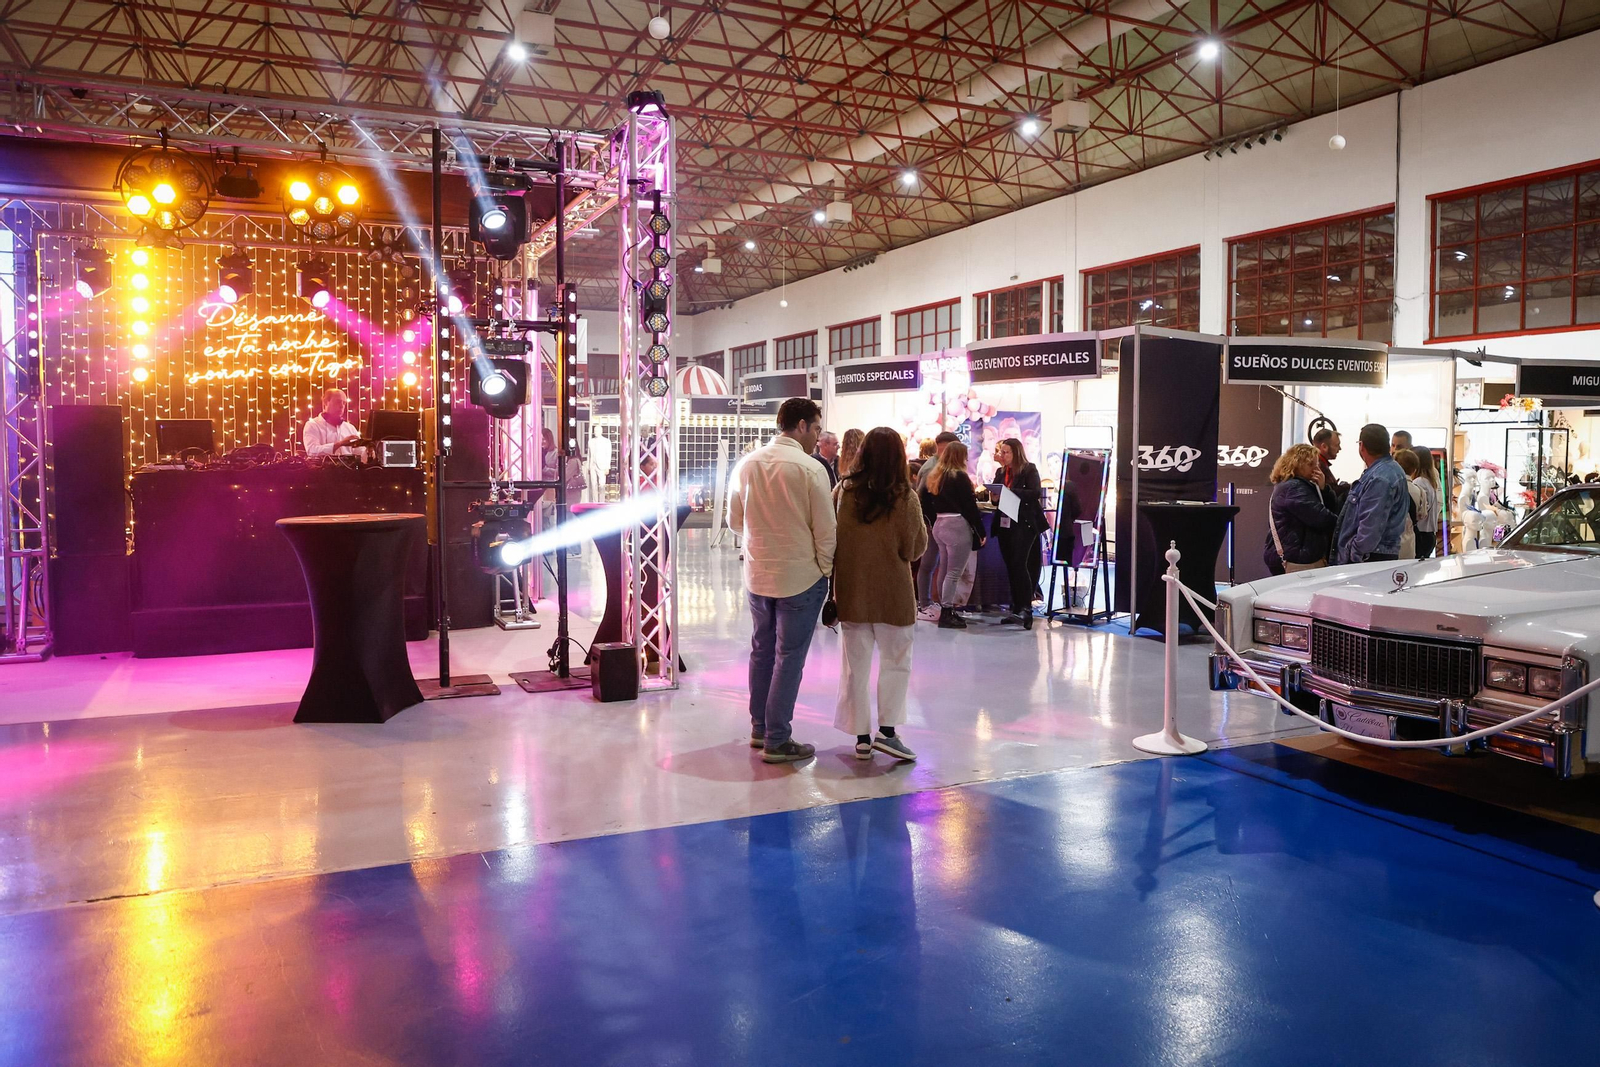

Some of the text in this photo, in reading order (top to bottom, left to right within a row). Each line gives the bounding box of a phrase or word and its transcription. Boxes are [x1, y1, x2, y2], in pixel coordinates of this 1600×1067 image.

[204, 330, 340, 358] esta noche
[268, 352, 361, 377] contigo
[984, 356, 1021, 370] EVENTOS
[1023, 351, 1090, 367] ESPECIALES
[1234, 354, 1289, 369] SUEÑOS
[1291, 357, 1335, 371] DULCES
[1337, 359, 1374, 372] EVENTOS
[842, 372, 866, 384] EVENTOS
[866, 369, 915, 382] ESPECIALES
[1138, 445, 1195, 473] 360
[1217, 445, 1263, 468] 360
[1348, 711, 1386, 728] Cadillac
